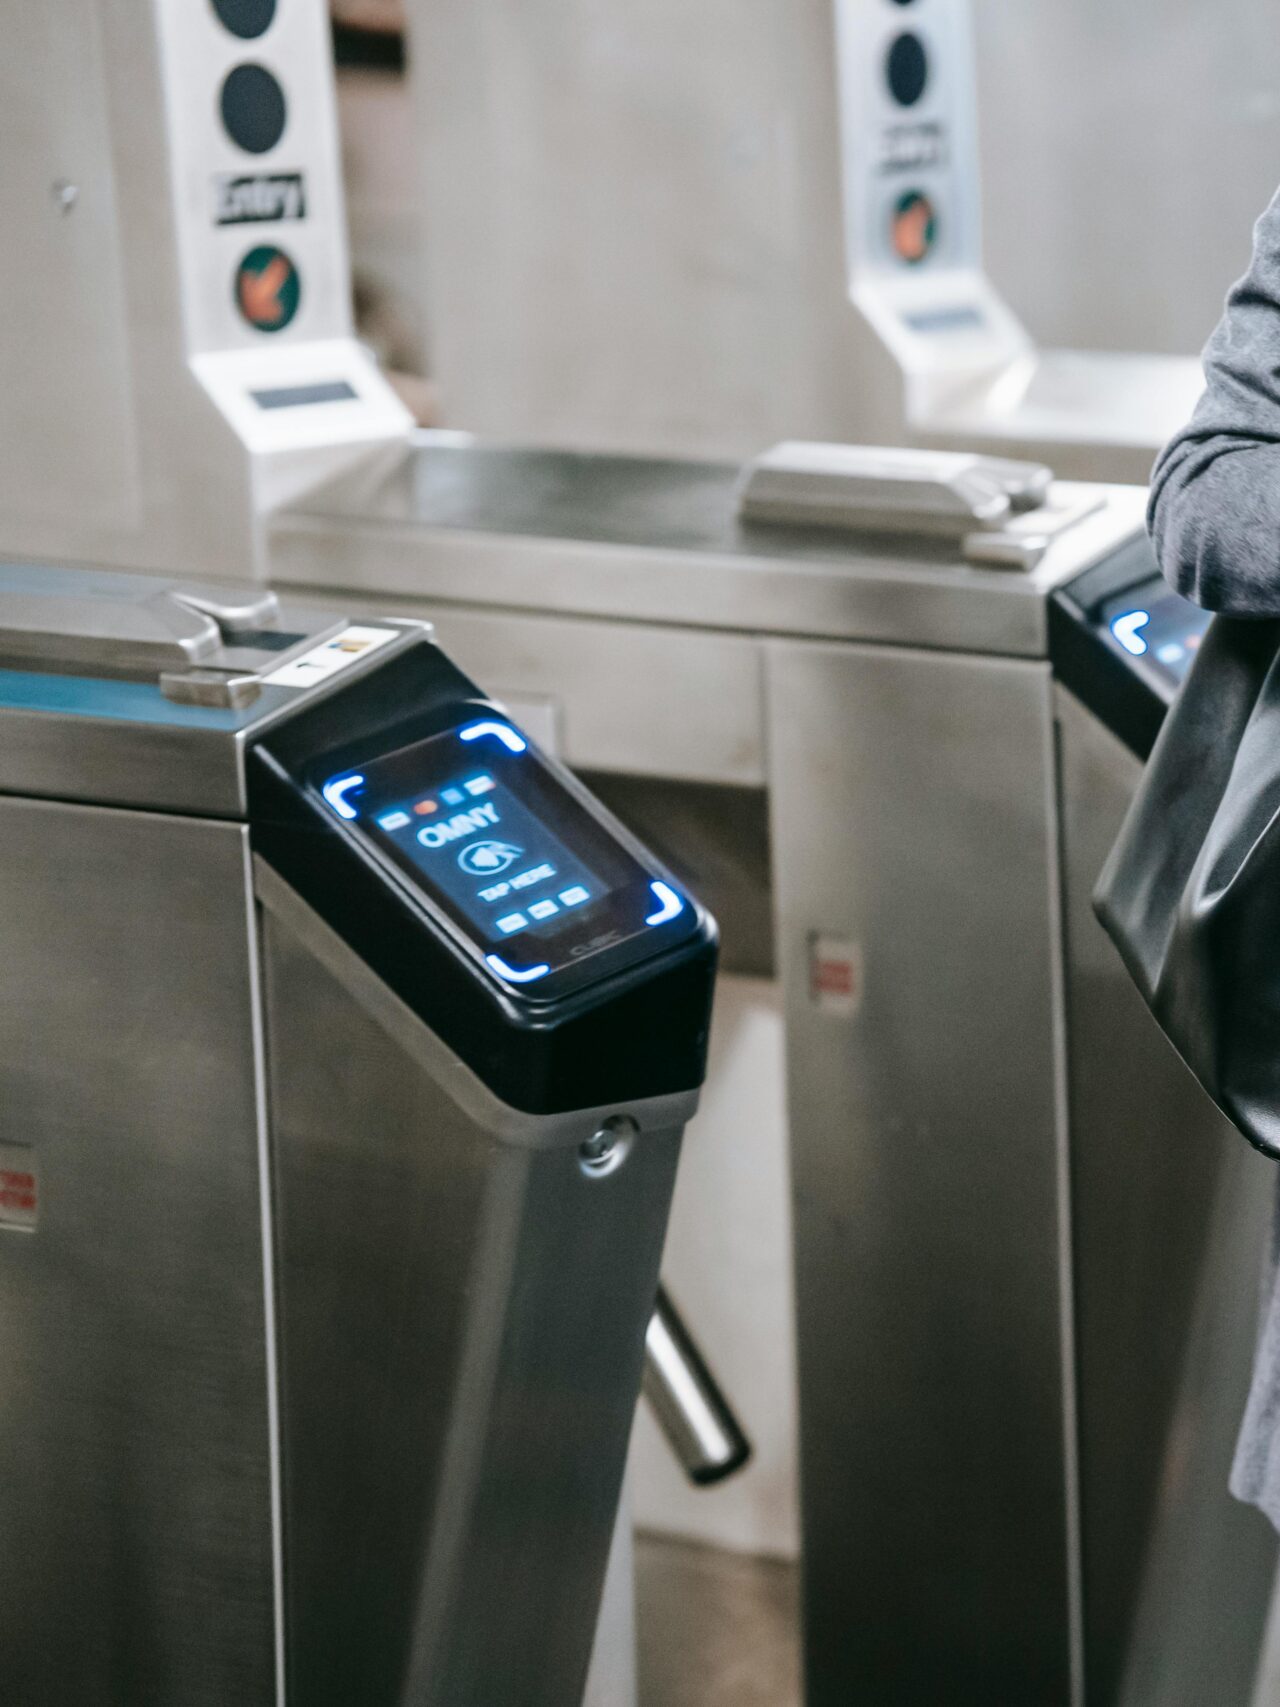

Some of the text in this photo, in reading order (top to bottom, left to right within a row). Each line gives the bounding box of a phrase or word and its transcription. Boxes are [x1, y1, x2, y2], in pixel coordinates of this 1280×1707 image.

[217, 176, 301, 222] Entry
[417, 802, 500, 848] OMNY
[478, 863, 557, 901] TAP HERE
